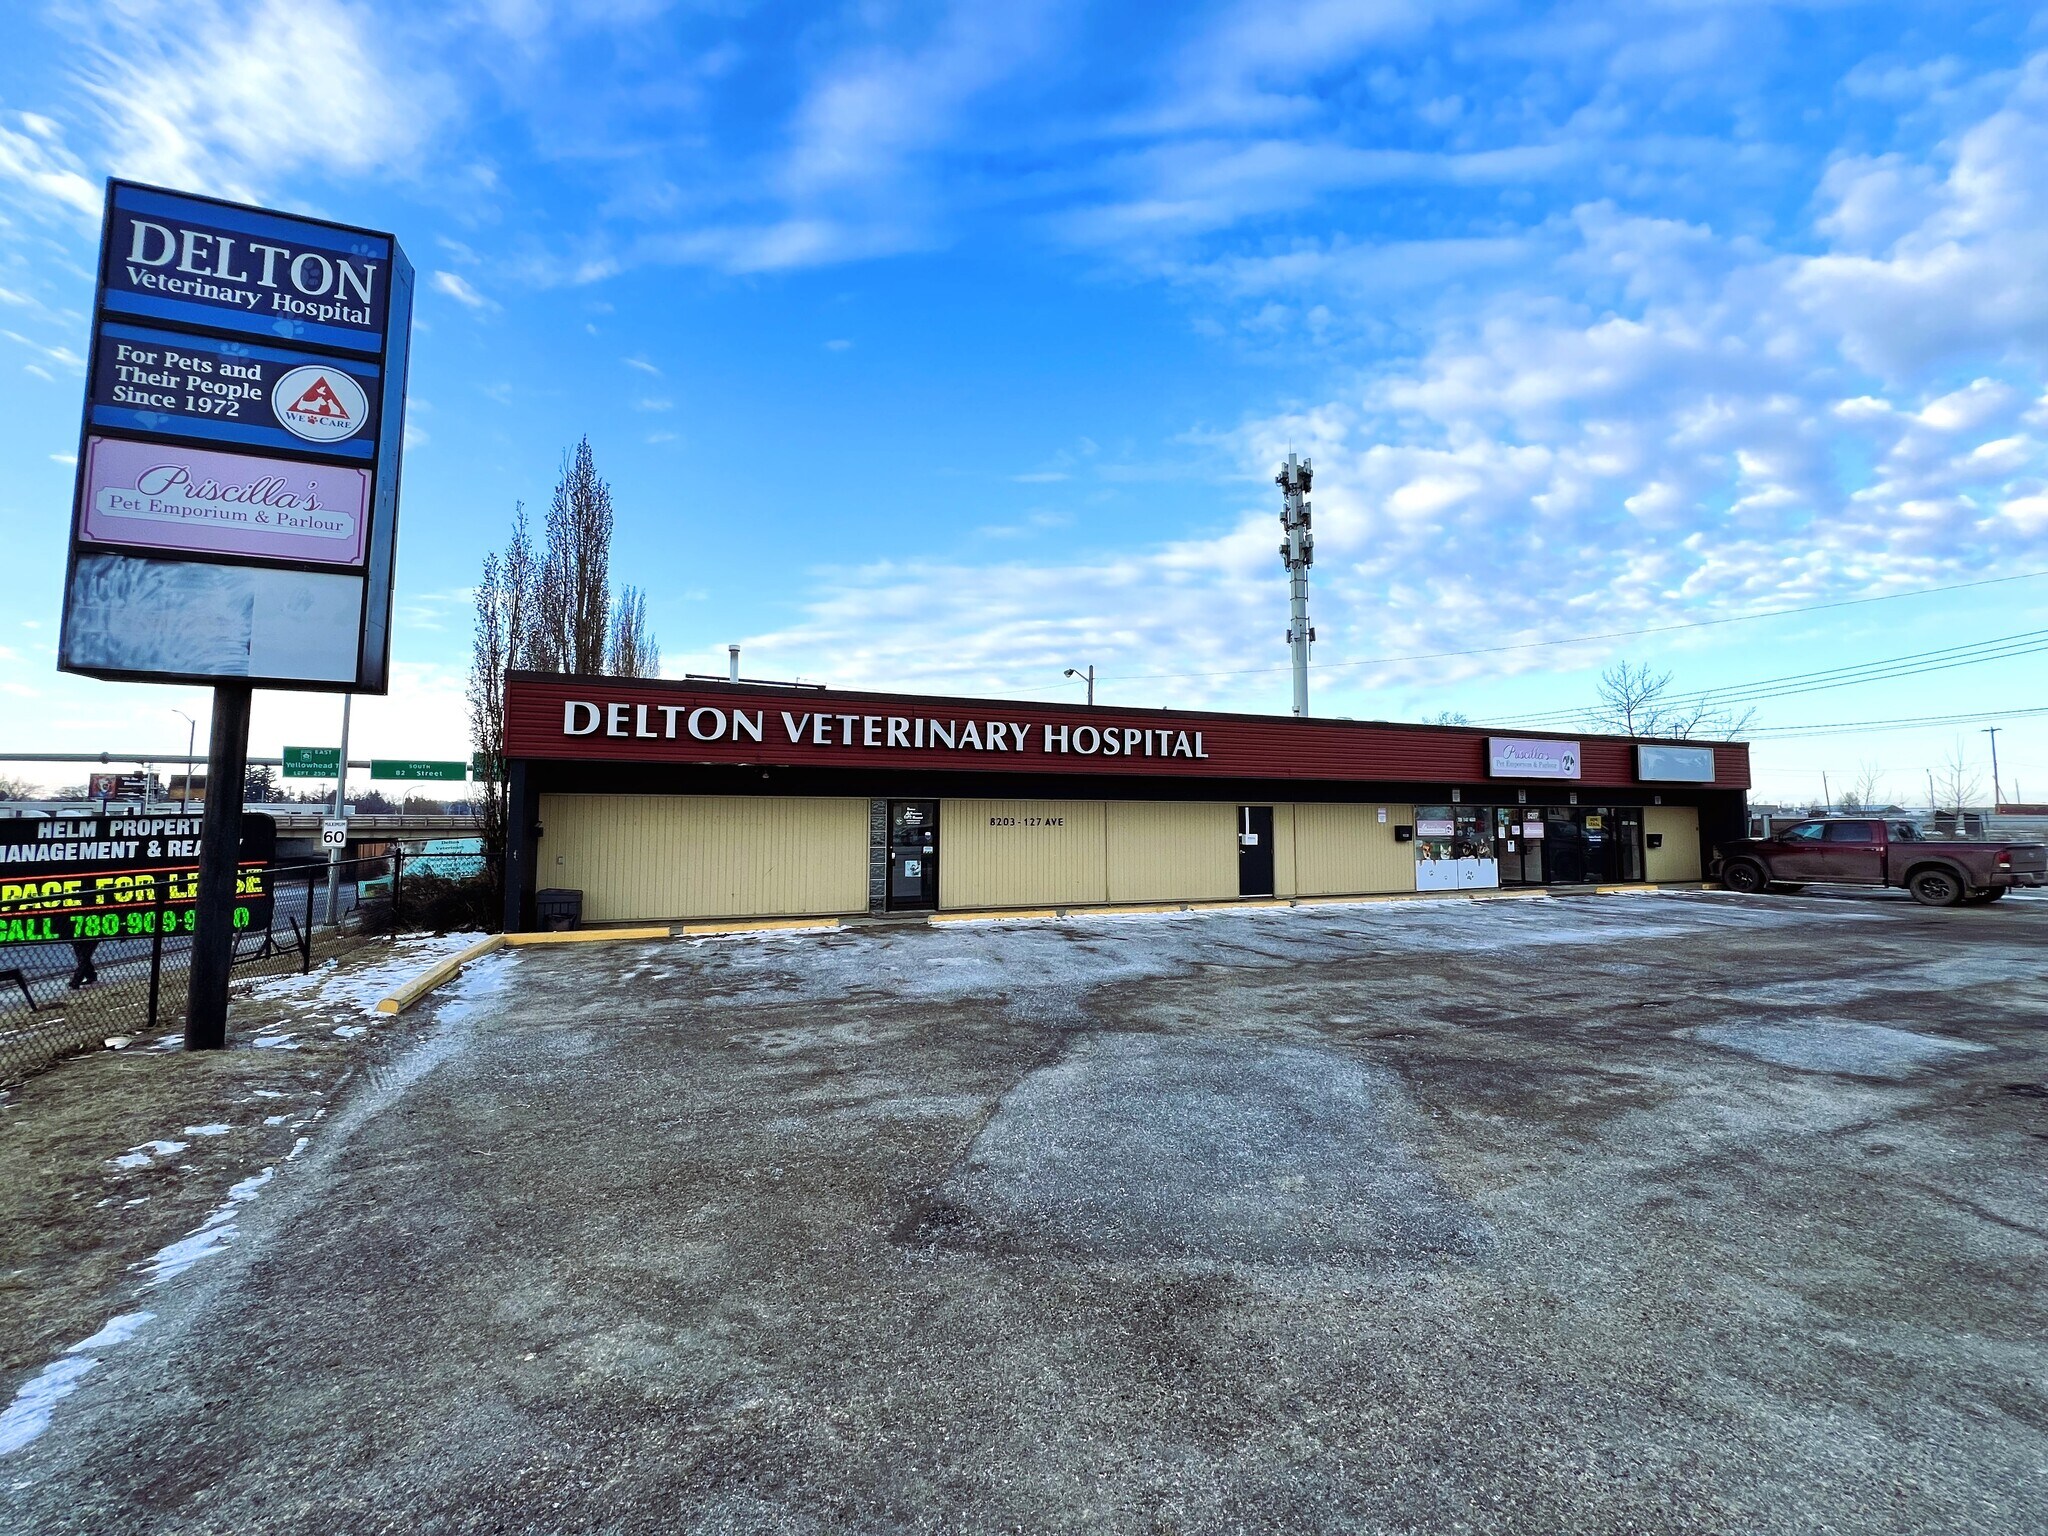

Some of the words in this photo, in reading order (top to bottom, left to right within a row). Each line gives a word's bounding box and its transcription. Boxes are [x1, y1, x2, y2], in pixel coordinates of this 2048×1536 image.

[126, 219, 377, 305] DELTON
[126, 265, 262, 310] Veterinary
[271, 292, 371, 325] Hospital
[117, 344, 157, 366] For
[164, 352, 212, 374] Pets
[220, 364, 262, 382] and
[115, 364, 180, 388] Their
[186, 376, 262, 401] People
[113, 385, 175, 408] Since
[185, 396, 239, 417] 1972
[286, 411, 306, 423] WE
[319, 416, 352, 429] CARE
[136, 464, 323, 512] Priscilla's
[109, 494, 141, 511] Pet
[149, 499, 248, 523] Emporium
[255, 510, 270, 524] &
[277, 512, 344, 532] Parlour
[563, 700, 763, 743] DELTON
[781, 711, 1031, 752] VETERINARY
[1044, 724, 1209, 759] HOSPITAL
[286, 761, 333, 769] Yellowhead
[37, 820, 97, 839] HELM
[109, 817, 202, 837] PROPERT
[323, 830, 345, 843] 60
[990, 817, 1015, 826] 8203
[1024, 817, 1042, 826] 127
[1045, 817, 1063, 826] AVE
[147, 841, 162, 857] &
[0, 880, 82, 912] PACE
[95, 875, 156, 905] FOR
[70, 907, 250, 939] 780-909-90
